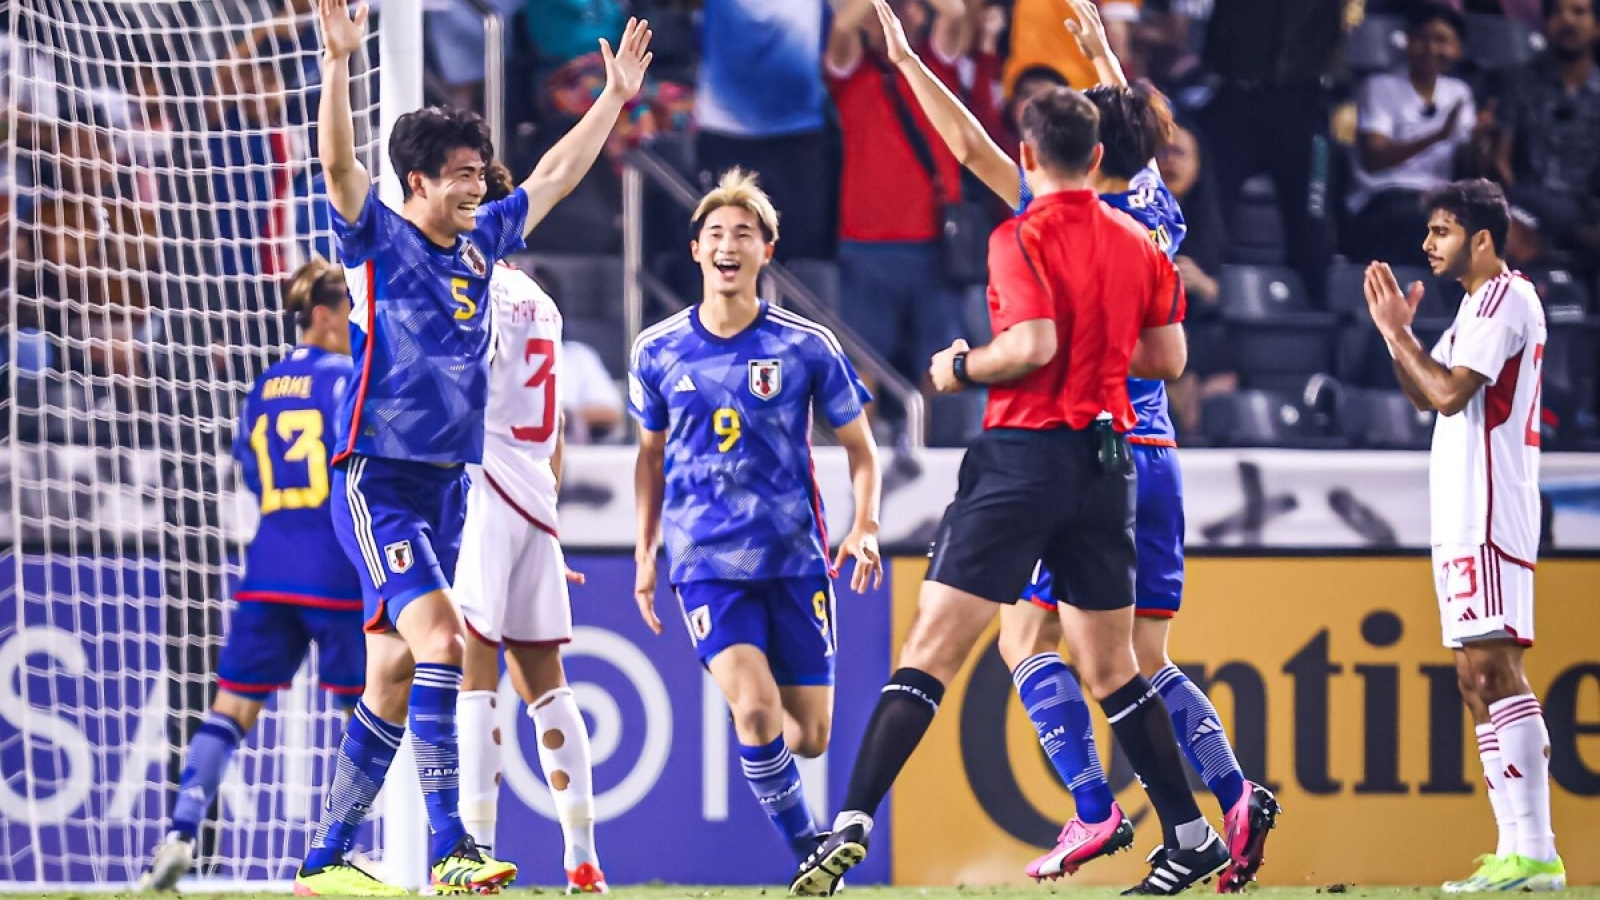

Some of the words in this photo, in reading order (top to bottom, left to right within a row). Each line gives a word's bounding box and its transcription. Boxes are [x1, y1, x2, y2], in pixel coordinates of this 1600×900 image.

[451, 278, 477, 320] 5
[511, 338, 556, 442] 3
[712, 408, 741, 453] 9
[251, 409, 329, 515] 13
[812, 590, 829, 637] 9
